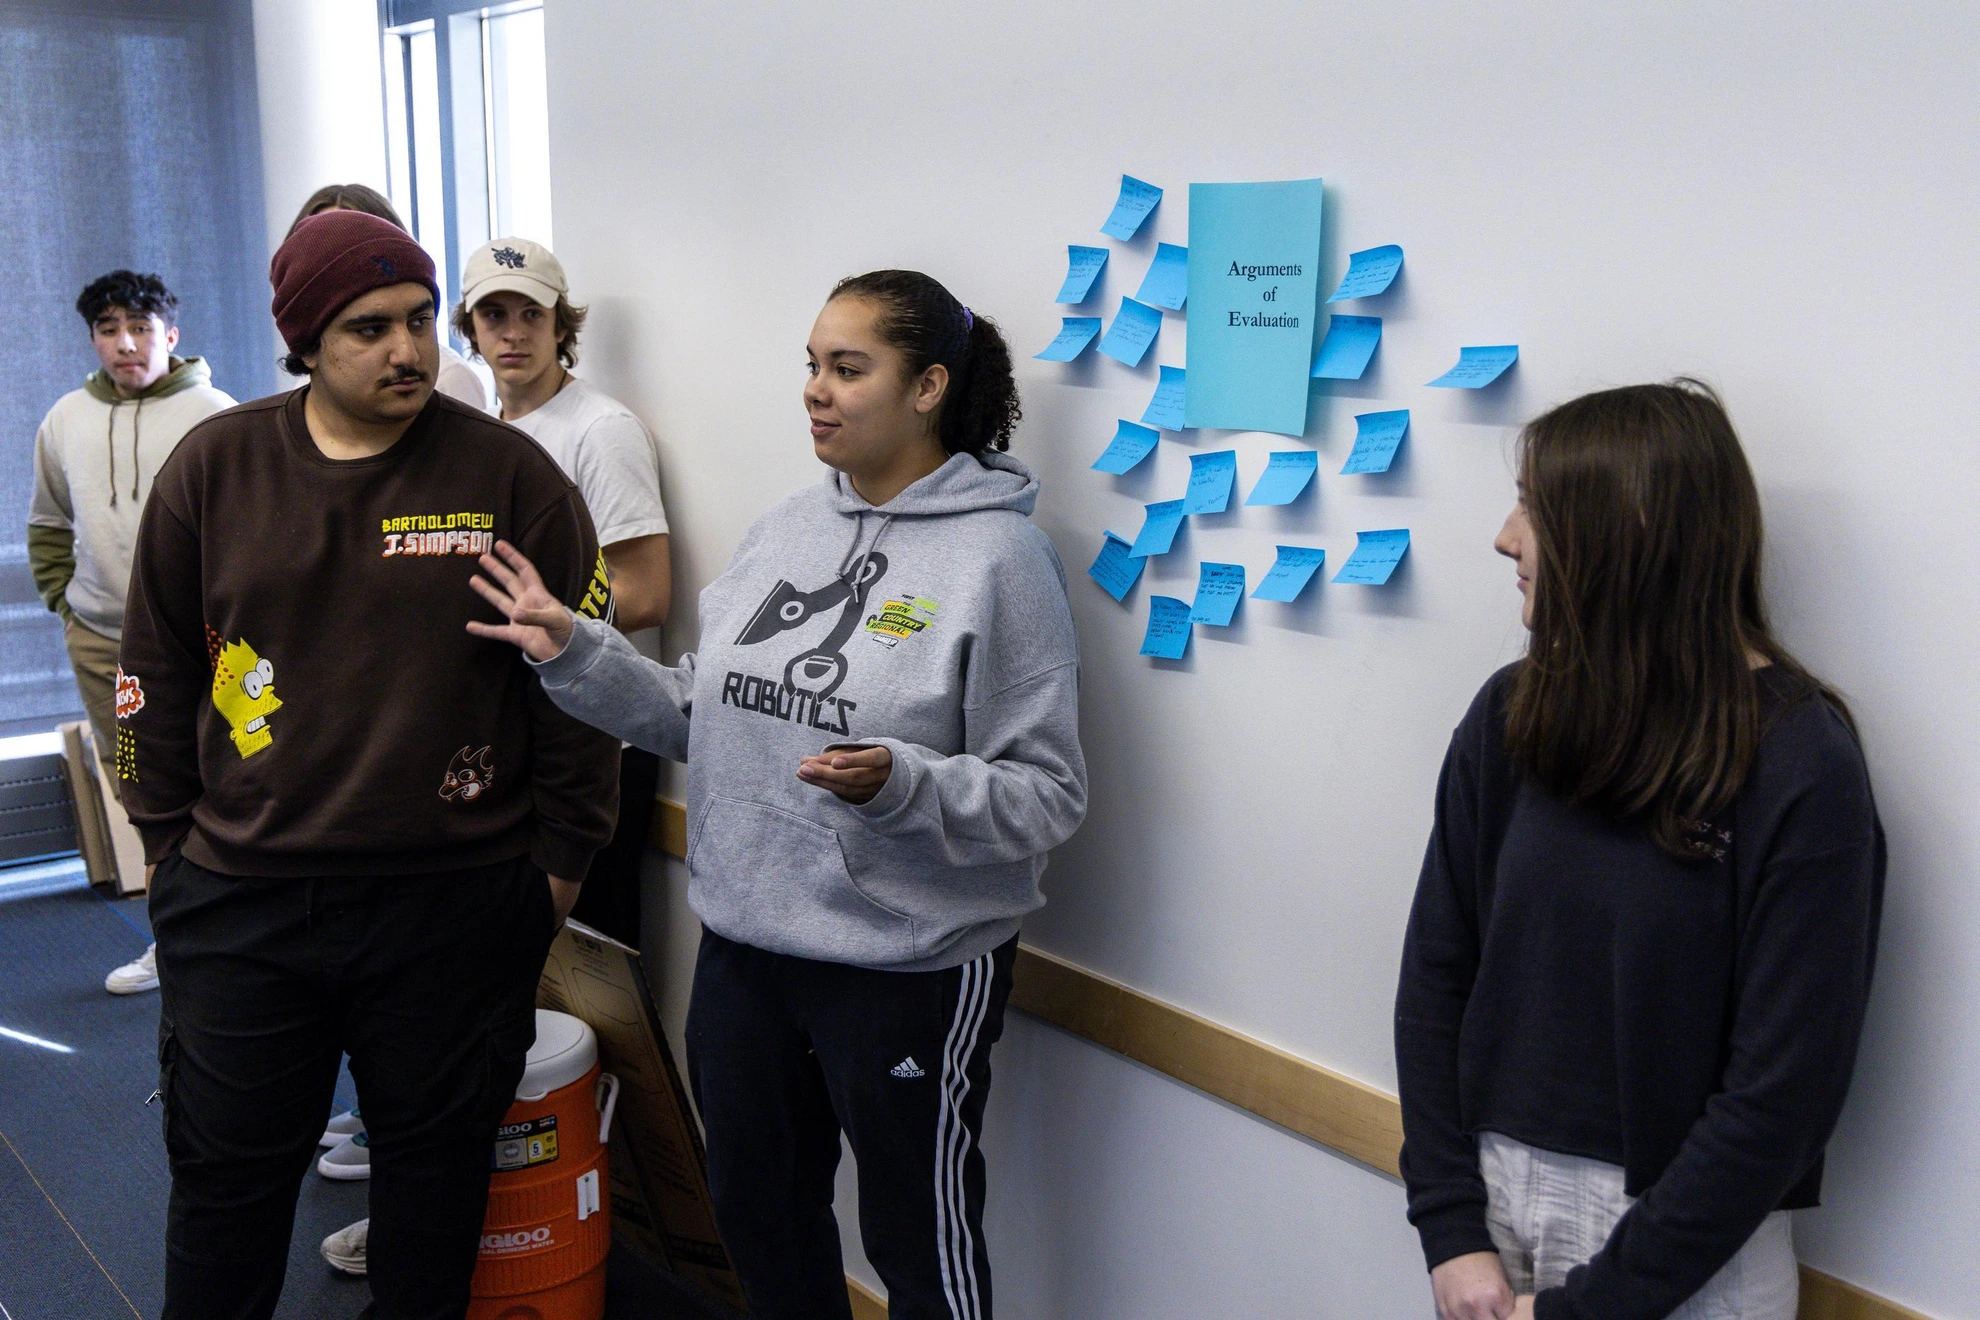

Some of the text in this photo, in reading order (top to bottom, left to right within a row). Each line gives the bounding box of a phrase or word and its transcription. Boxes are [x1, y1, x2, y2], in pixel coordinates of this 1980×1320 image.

[1227, 260, 1302, 282] Arguments
[1262, 286, 1278, 302] of
[1227, 311, 1300, 329] Evaluation
[382, 512, 494, 532] BARTHOLOMEW
[884, 604, 910, 614] GREEN
[869, 622, 905, 635] REGIONAL
[882, 614, 922, 629] COUNTRY
[722, 671, 857, 736] ROBOTICS
[890, 1069, 925, 1078] adidas
[533, 1143, 539, 1153] 5
[531, 1239, 555, 1249] WATER
